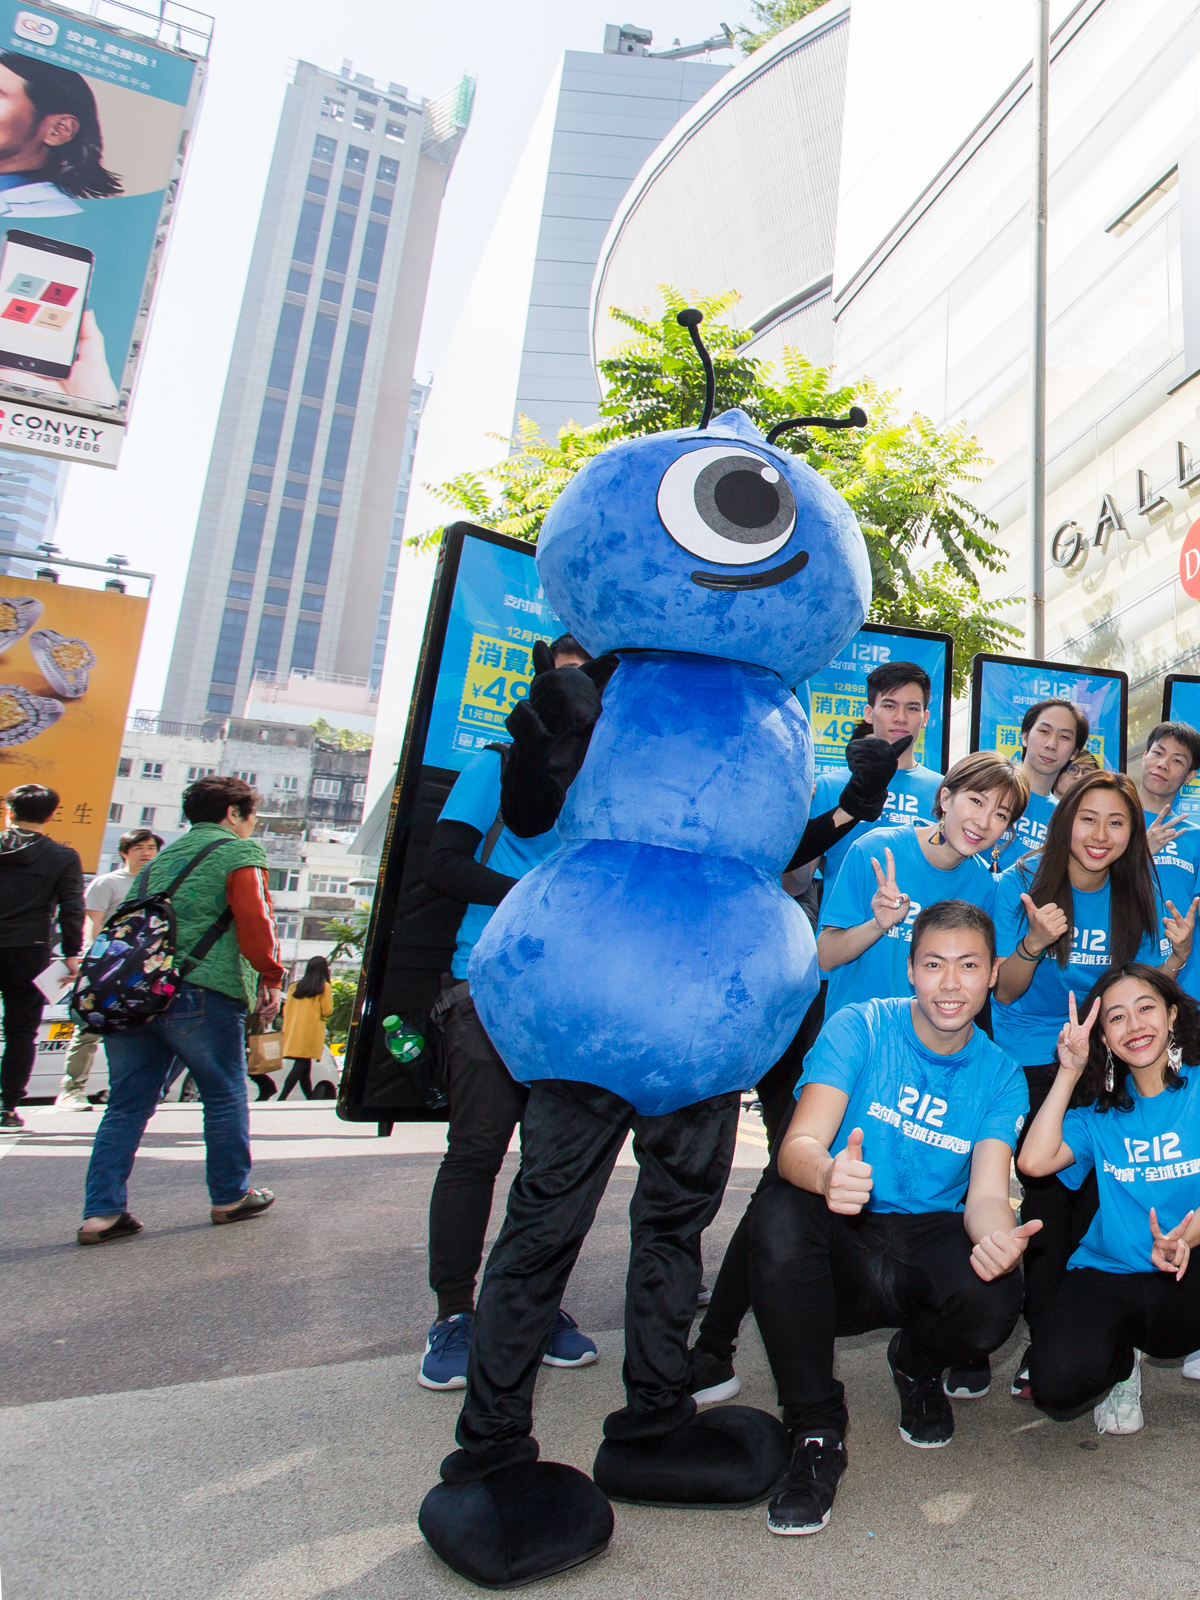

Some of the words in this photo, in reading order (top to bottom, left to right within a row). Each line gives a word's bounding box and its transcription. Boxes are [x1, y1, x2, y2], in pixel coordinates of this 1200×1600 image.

[12, 413, 104, 442] CONVEY
[27, 430, 61, 446] 2739
[65, 437, 100, 453] 3806
[476, 639, 535, 676] 消費
[852, 643, 891, 663] 1212
[1124, 1132, 1182, 1163] 1212
